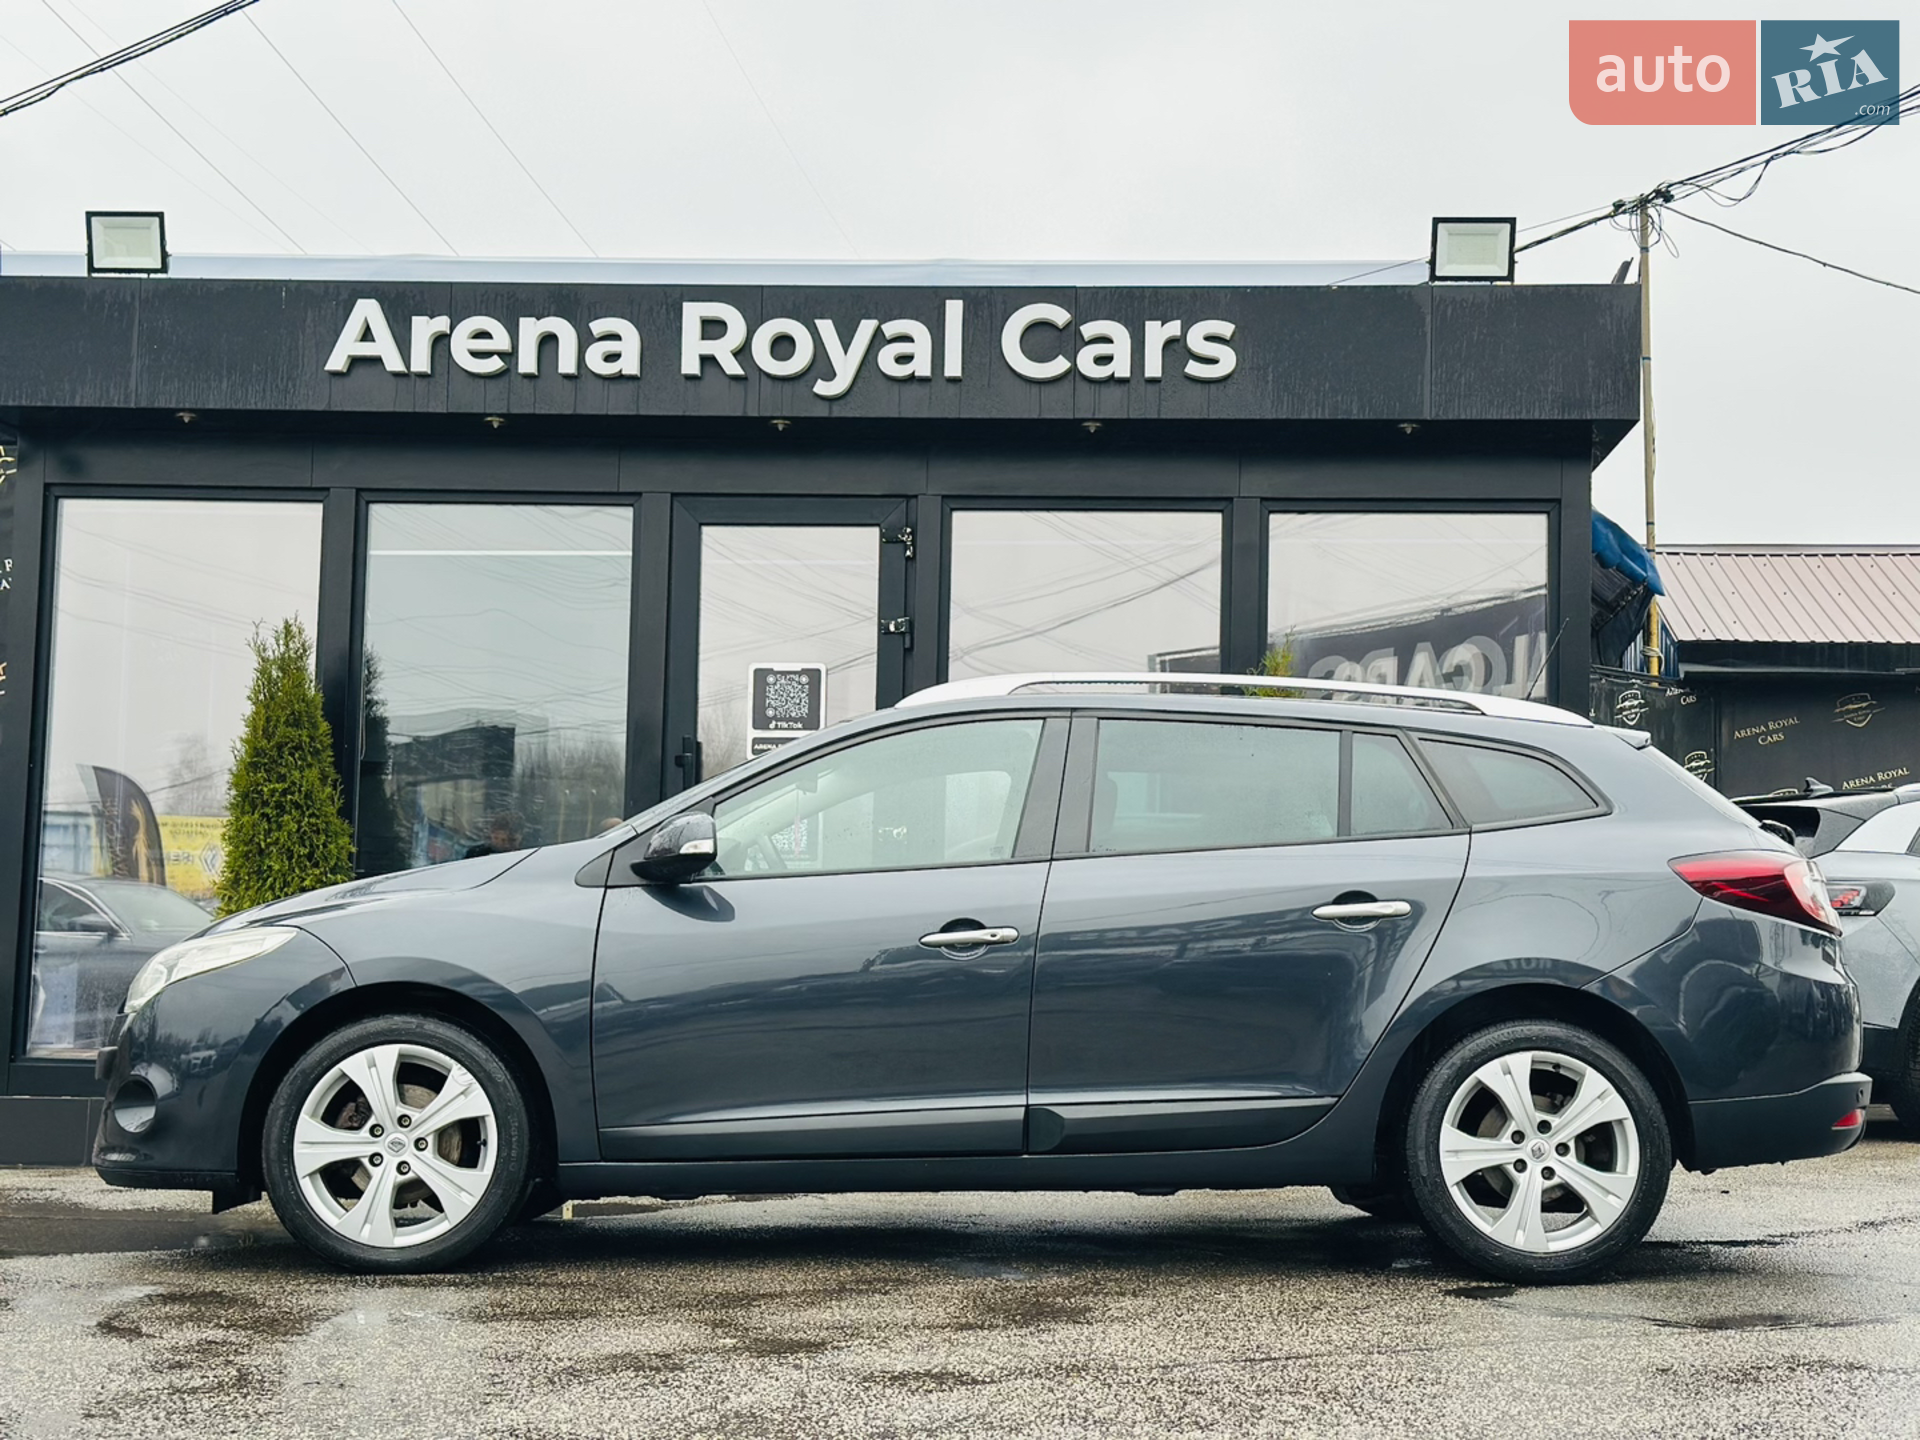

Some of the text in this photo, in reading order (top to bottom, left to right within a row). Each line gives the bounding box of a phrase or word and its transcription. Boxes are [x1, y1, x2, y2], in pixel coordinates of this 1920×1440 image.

[324, 298, 1237, 399] Arena Royal Cars
[777, 721, 803, 729] TikTok
